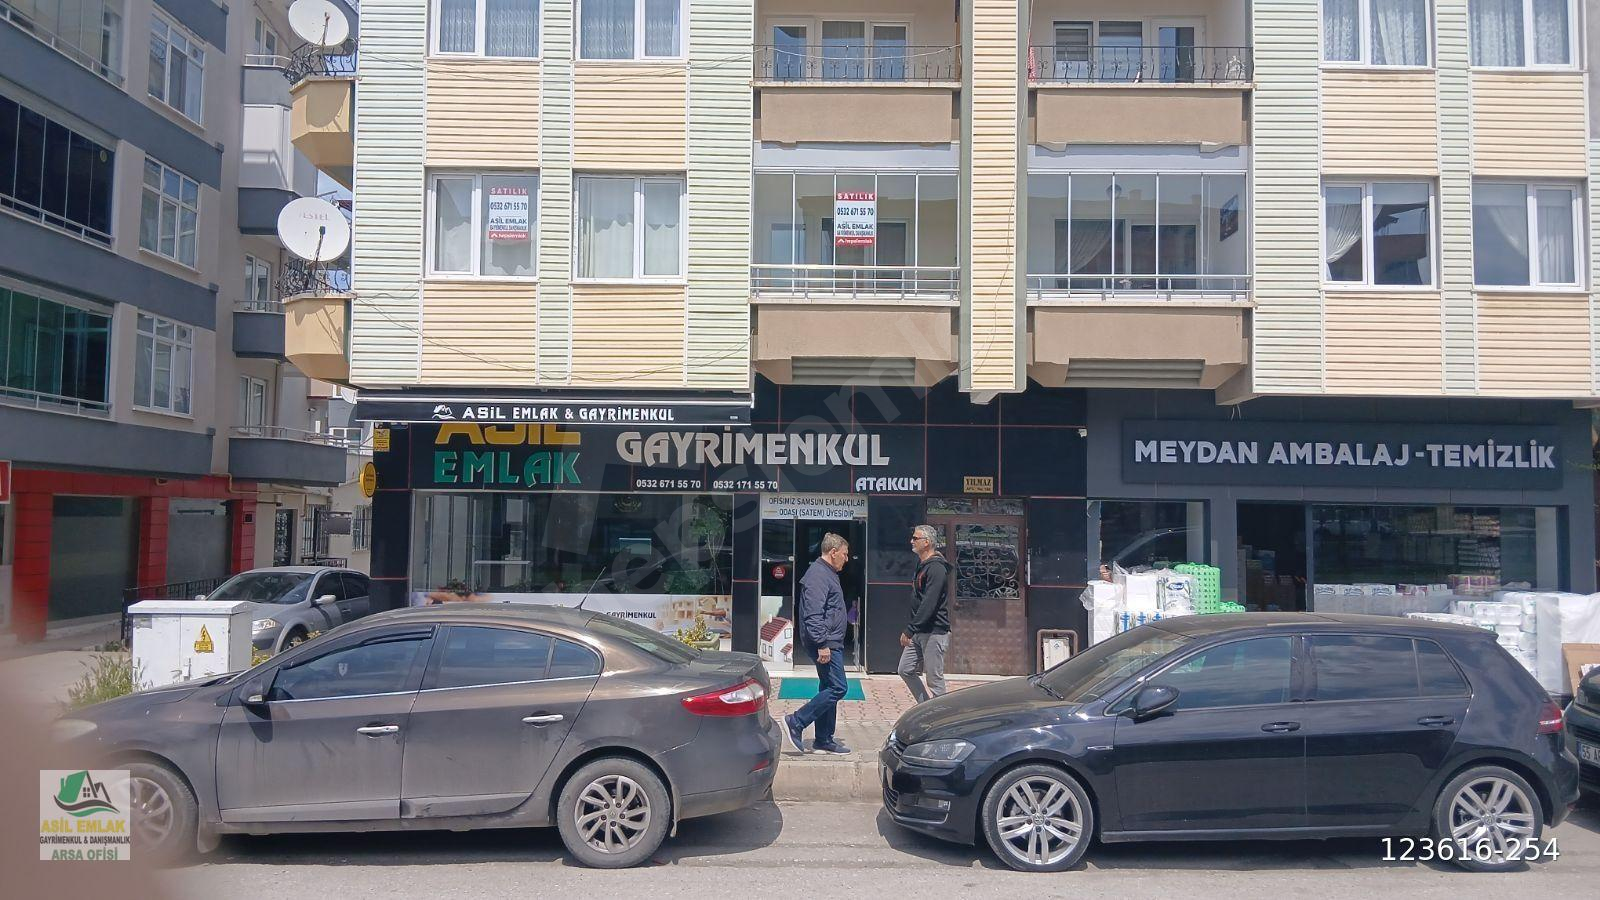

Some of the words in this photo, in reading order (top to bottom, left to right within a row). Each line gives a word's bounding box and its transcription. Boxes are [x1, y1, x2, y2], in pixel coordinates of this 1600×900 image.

[490, 202, 503, 210] 0532
[504, 202, 512, 210] 671
[514, 202, 520, 210] 55
[521, 202, 528, 210] 70
[837, 207, 850, 215] 0532
[513, 407, 558, 421] EMLAK
[565, 408, 574, 419] &
[579, 406, 674, 422] GAYRİMENKUL
[616, 425, 890, 468] GAYRİMENKUL
[1135, 440, 1258, 464] MEYDAN
[434, 451, 581, 488] EMLAK
[636, 480, 657, 488] 0532
[659, 480, 675, 489] 671
[677, 480, 688, 489] 55
[691, 480, 701, 489] 70
[713, 481, 733, 489] 0532
[736, 481, 751, 489] 171
[754, 481, 765, 489] 55
[767, 481, 778, 489] 70
[856, 477, 922, 492] ATAKUM
[797, 498, 823, 506] SAMSUN
